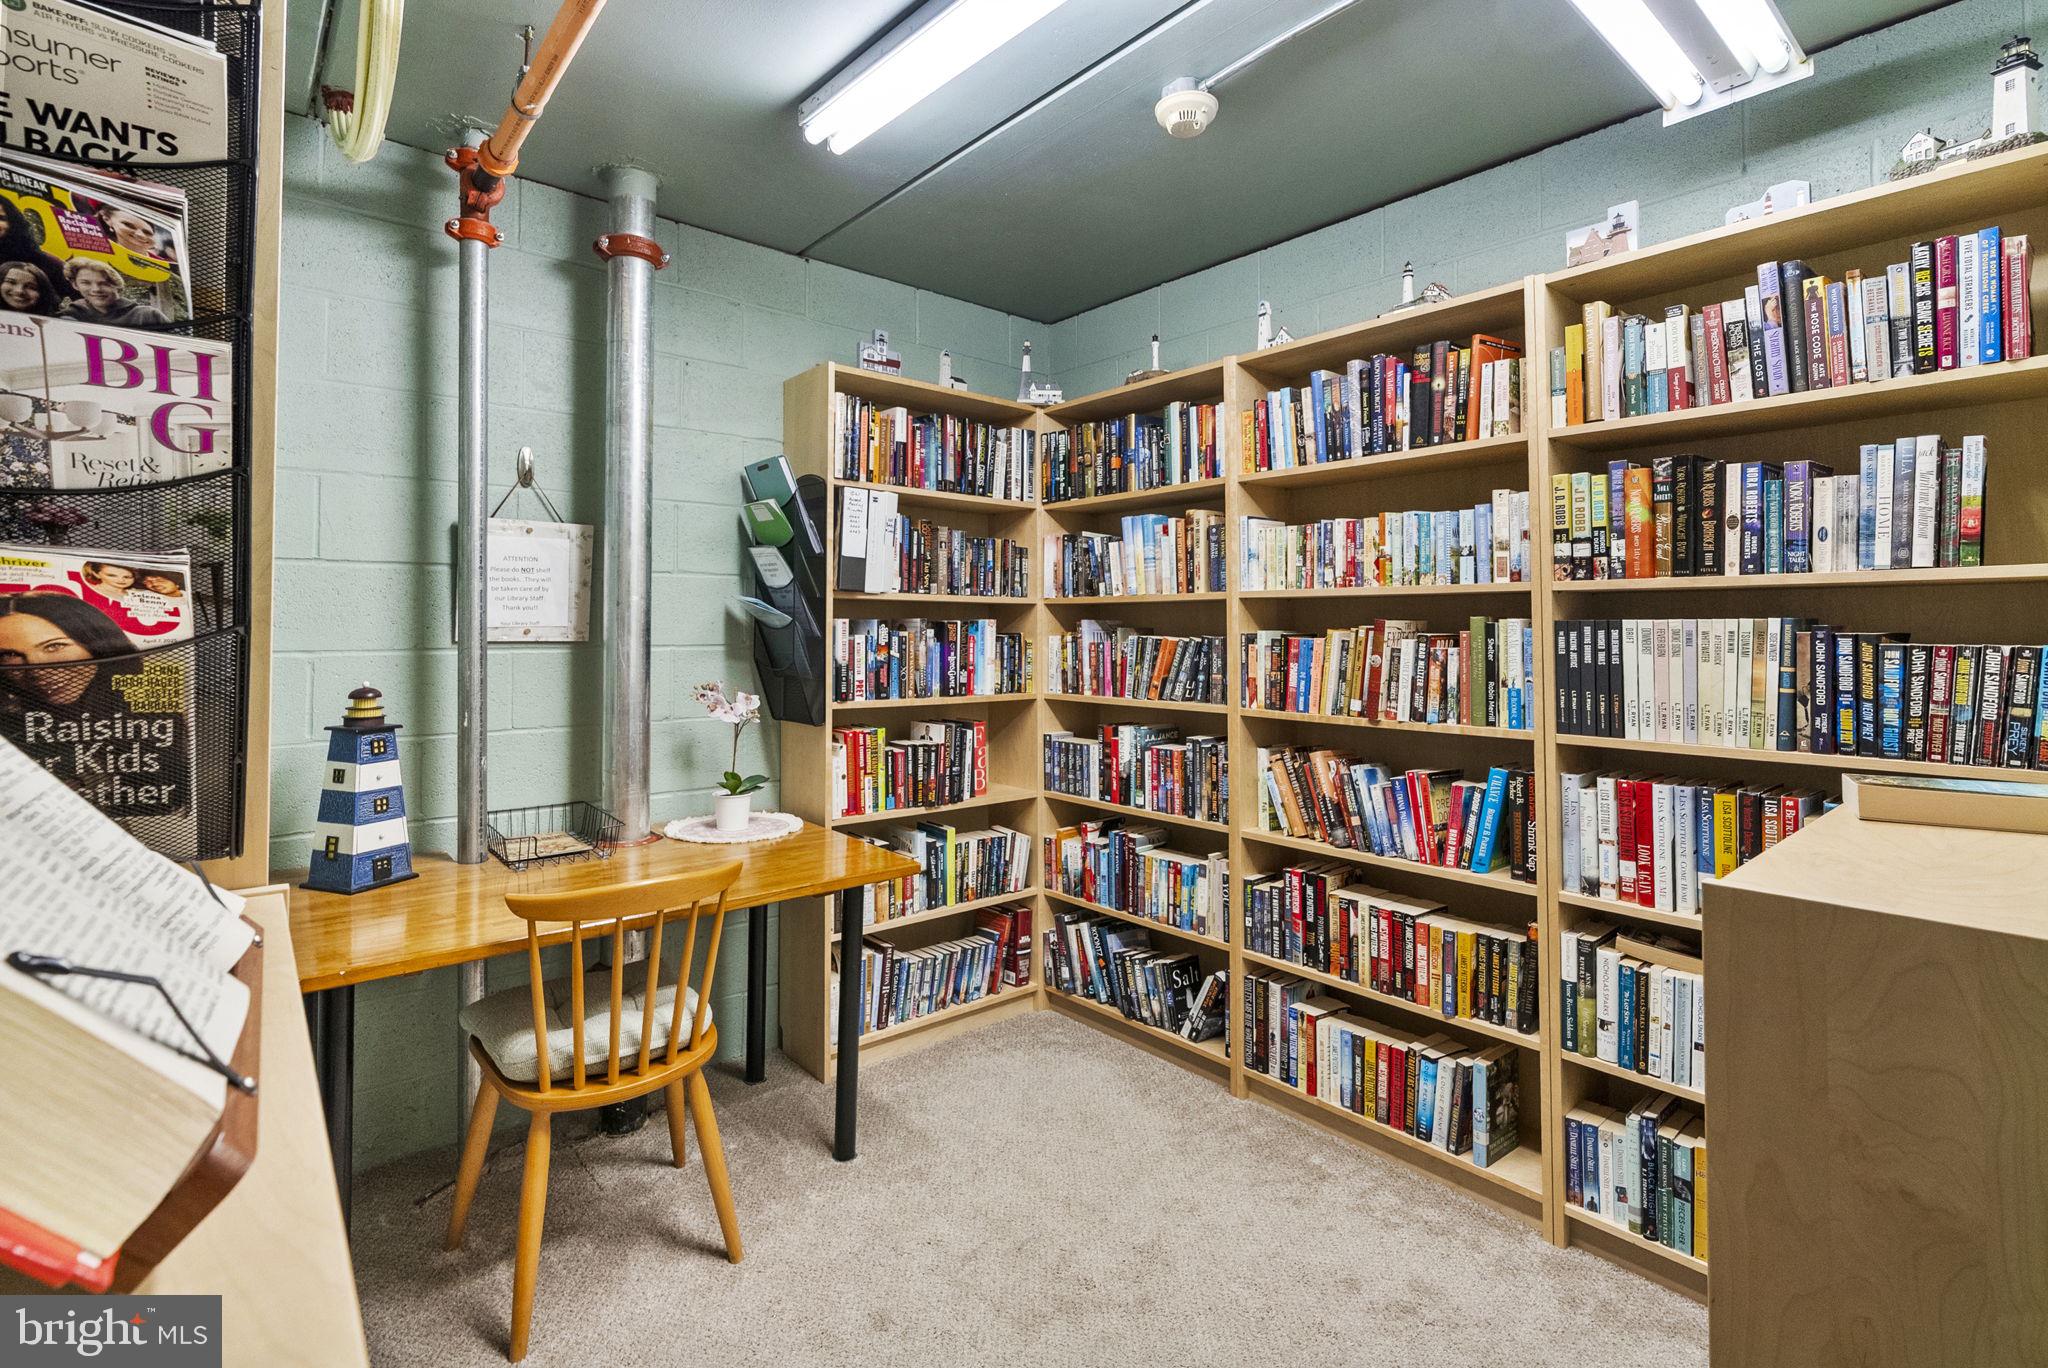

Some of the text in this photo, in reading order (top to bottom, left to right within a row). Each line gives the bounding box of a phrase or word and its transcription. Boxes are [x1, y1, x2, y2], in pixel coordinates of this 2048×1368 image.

[55, 16, 96, 36] FRYERS
[110, 34, 161, 61] PRESSURE
[161, 54, 206, 76] COOKERS
[23, 126, 138, 163] BACK
[25, 97, 180, 158] WANTS
[11, 172, 49, 194] BREAK
[1989, 246, 1997, 258] THE
[1989, 259, 1997, 277] BOOK
[1964, 239, 1974, 311] FIVE TOTAL STRANGERS
[1914, 245, 1933, 357] KATHY REICHS GRAVE SECRETS
[1810, 313, 1821, 334] ROSE
[1753, 338, 1764, 381] THE LOST
[1812, 335, 1822, 359] CODE
[1386, 370, 1394, 399] Wildfire
[70, 451, 162, 476] Reset &
[977, 464, 986, 486] CRISIS
[1865, 449, 1874, 500] HOUSEKEEPING
[1746, 467, 1758, 523] NORA ROBERTS
[1789, 480, 1804, 531] NORA ROBERTS
[1574, 506, 1586, 533] ROBB
[1656, 512, 1672, 560] River's End
[1877, 496, 1891, 539] HOME
[1917, 505, 1934, 539] Robinson
[1416, 642, 1427, 686] BRAD MELTZER
[1486, 637, 1496, 662] Shelter
[855, 679, 865, 698] PREY
[1815, 640, 1827, 706] JOHN SANDFORD
[1861, 642, 1873, 741] JOHN SANDFORD NEON PREY
[1909, 648, 1926, 717] JOHN SANDFORD
[1982, 648, 2002, 720] JOHN SANDFORD
[2013, 658, 2029, 704] JOHN SANDFORD
[1487, 681, 1497, 722] Robin Merrill
[1883, 659, 1900, 752] SANDFORD HOLY GHOST
[25, 710, 176, 749] Raising
[1914, 728, 1923, 752] GOLDEN
[2008, 721, 2020, 756] PREY
[73, 742, 161, 776] Kids
[870, 734, 879, 787] JANET EVANOVICH
[1488, 775, 1503, 804] CHANCE
[1563, 786, 1571, 828] SCOTTOLINE
[1463, 791, 1480, 849] ROOM WHITE FIRE
[1701, 797, 1713, 857] LISA SCOTTOLINE
[1722, 800, 1733, 855] LISA SCOTTOLINE
[1446, 828, 1458, 866] BRAD PARKS
[1637, 844, 1652, 866] LOOK
[1639, 869, 1653, 895] AGAIN
[1405, 925, 1414, 969] JAMES PATTERSON
[891, 975, 899, 1006] GRAFTON
[1171, 967, 1199, 989] Salt
[1602, 957, 1610, 1016] NICHOLAS SPARKS
[1406, 1055, 1416, 1128] TRAVELERS CHRIS PAVONE
[1421, 1061, 1430, 1112] LOUISE PENNY
[1437, 1075, 1447, 1131] LOUISE PENNY
